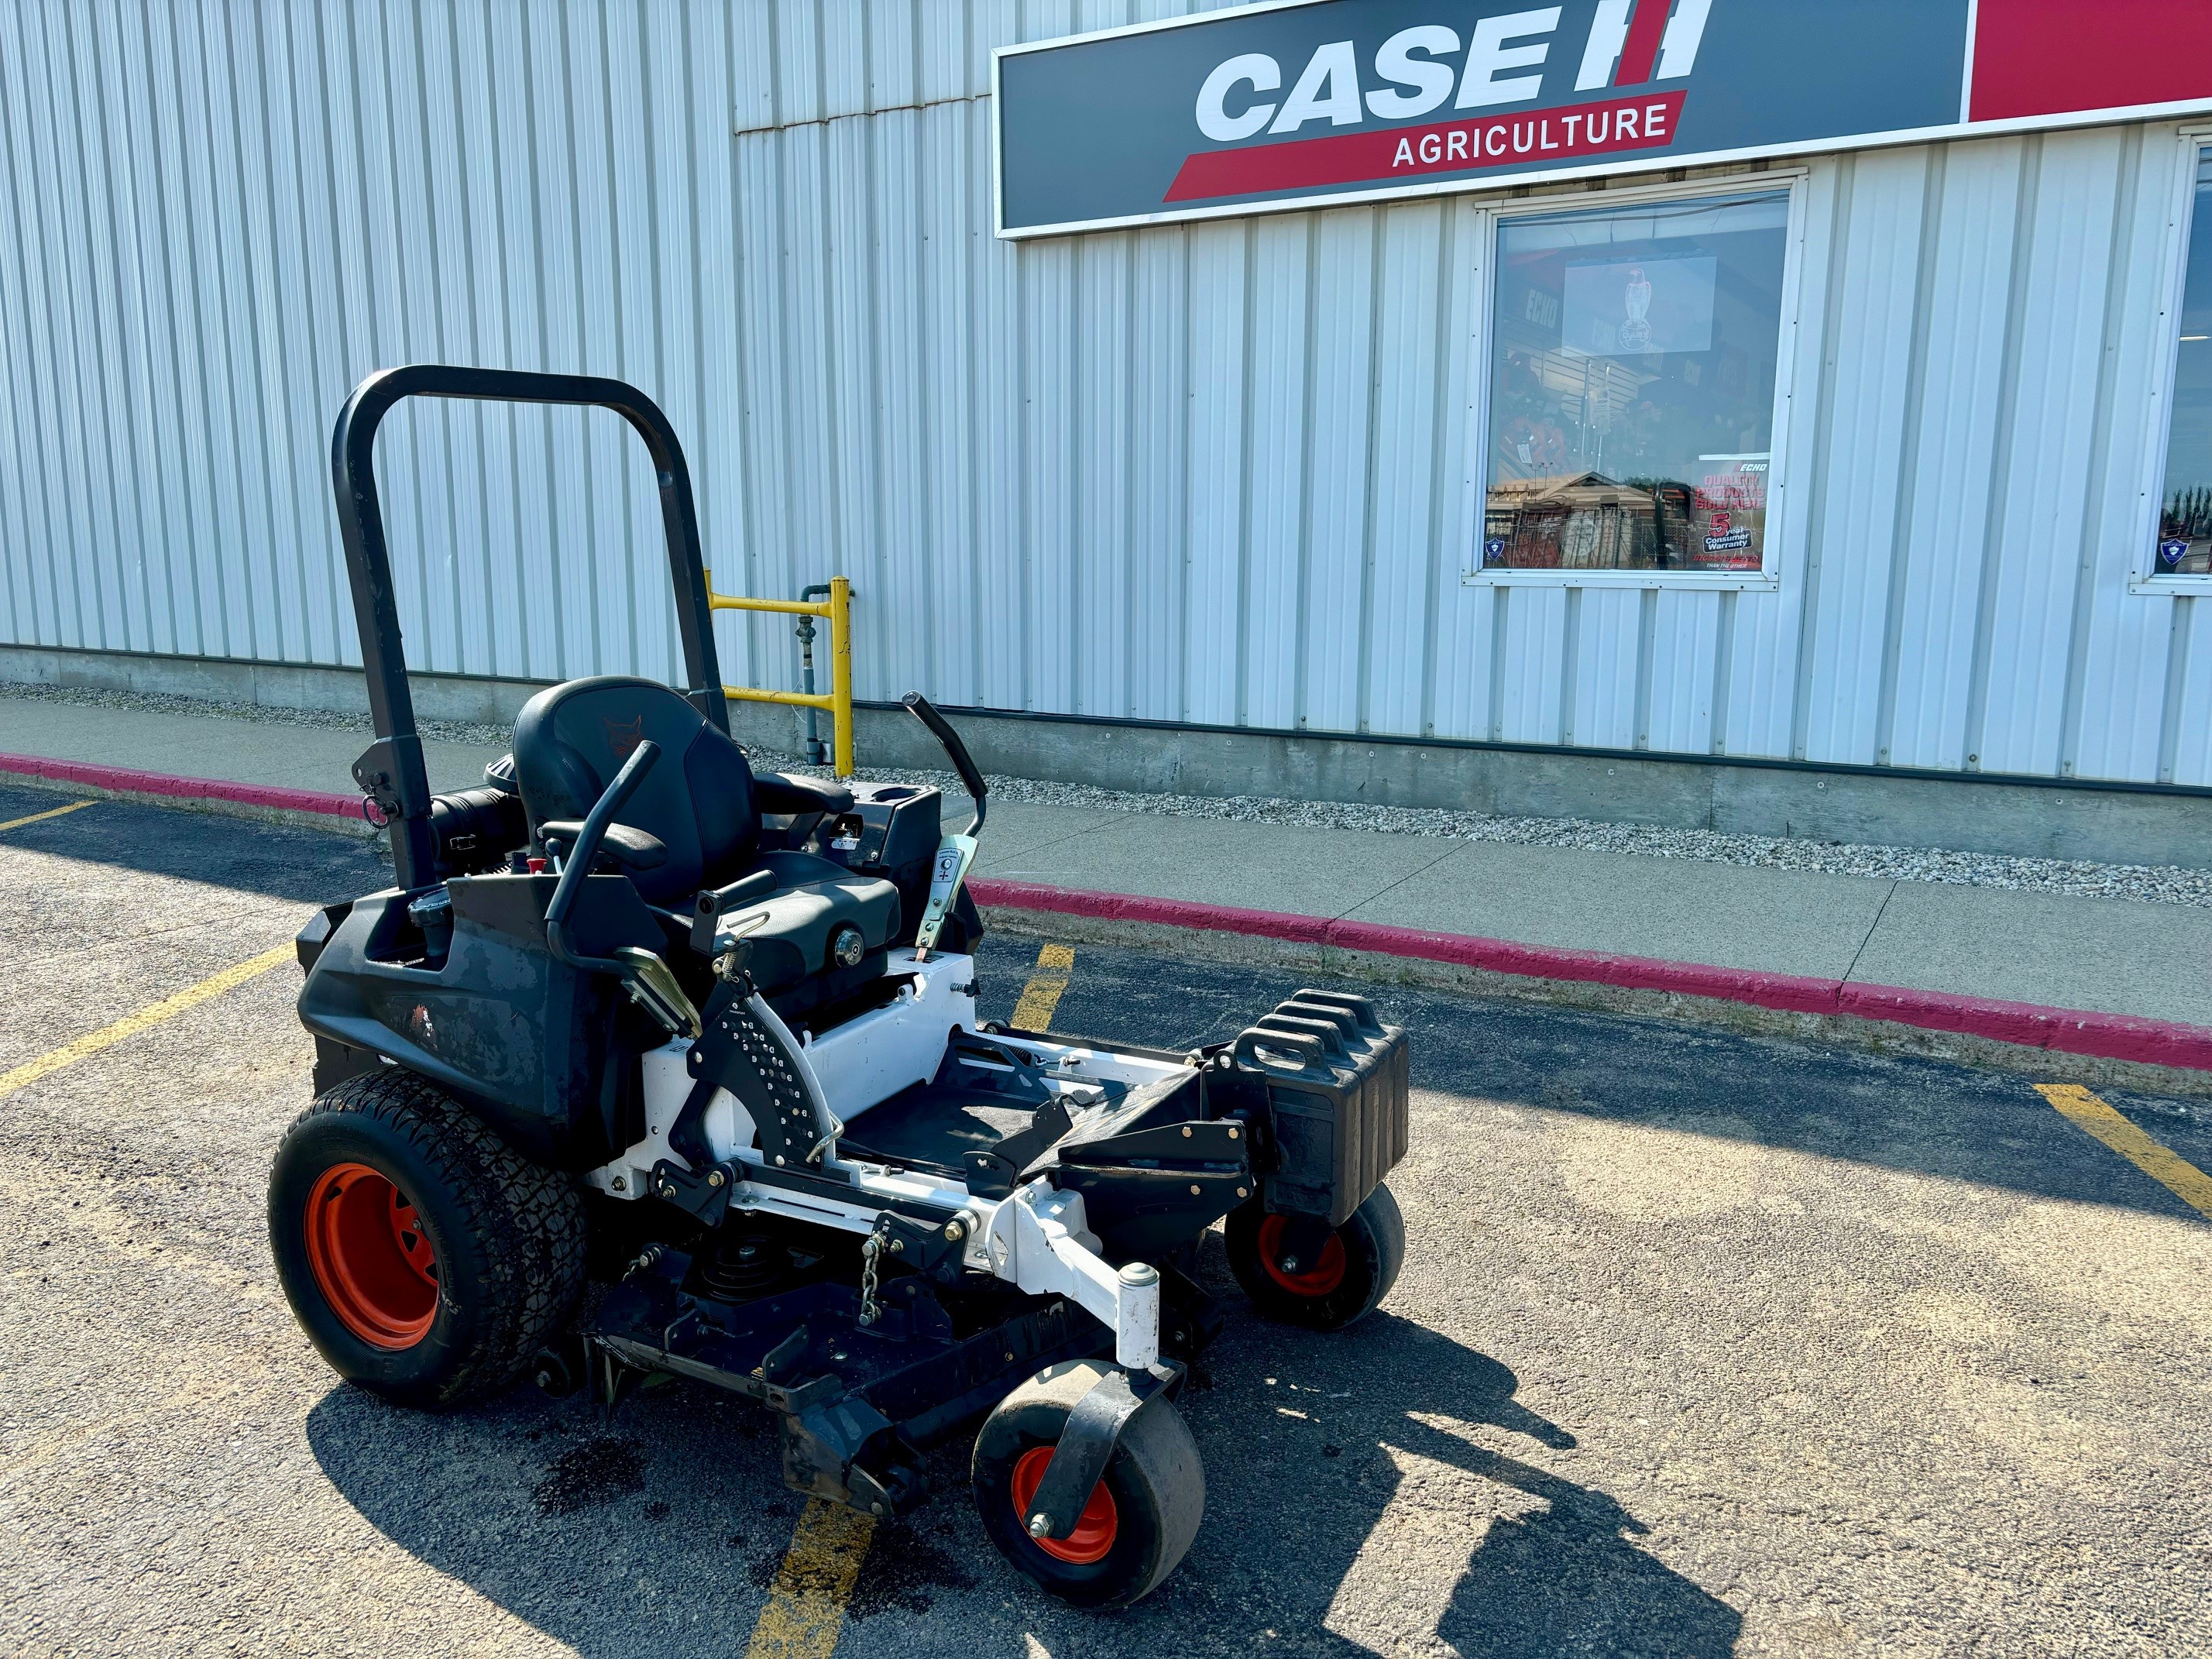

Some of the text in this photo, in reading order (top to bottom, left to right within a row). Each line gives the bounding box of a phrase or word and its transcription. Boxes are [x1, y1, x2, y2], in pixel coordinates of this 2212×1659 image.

[1196, 6, 1562, 142] CASE
[1392, 103, 1667, 167] AGRICULTURE
[1740, 463, 1767, 472] ECHO
[1704, 475, 1759, 486] QUALITY
[1695, 486, 1764, 498] PRODUCTS
[1695, 498, 1728, 510] SOLD
[1708, 511, 1745, 538] 5 year
[1705, 533, 1750, 544] Consumer
[1708, 540, 1748, 551] Warranty
